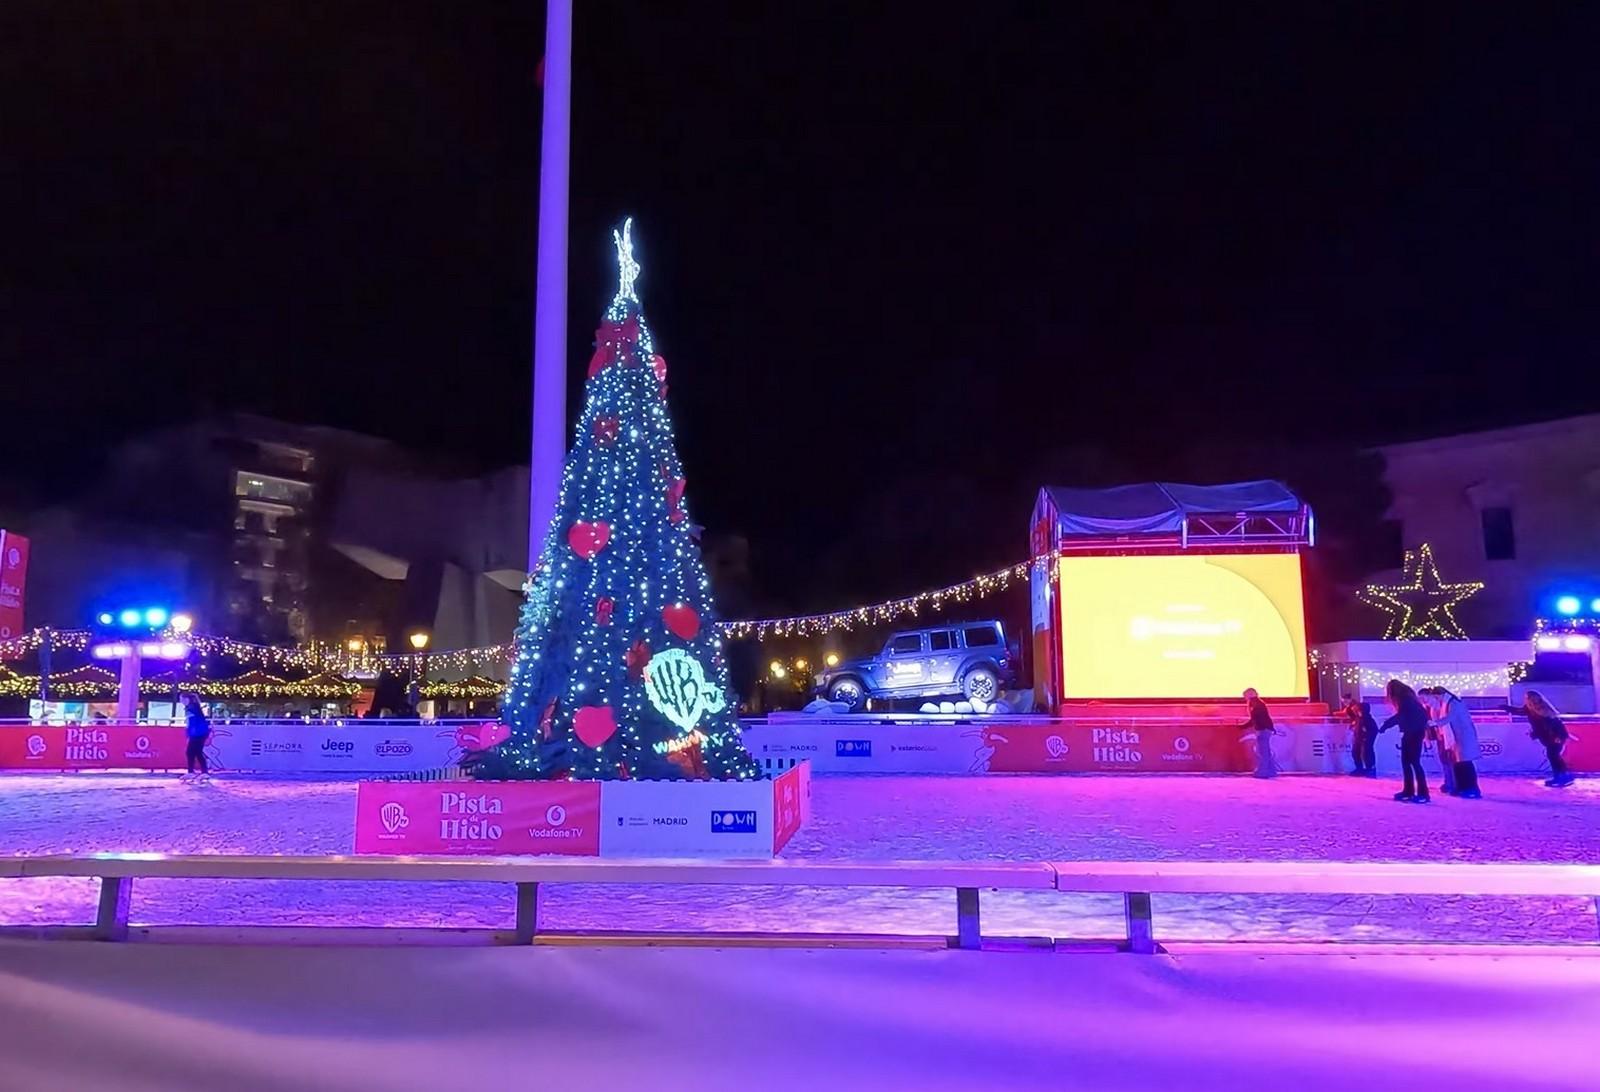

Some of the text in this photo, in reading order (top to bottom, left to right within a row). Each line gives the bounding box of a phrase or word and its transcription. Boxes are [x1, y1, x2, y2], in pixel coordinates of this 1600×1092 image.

[66, 728, 108, 743] Pista
[1093, 728, 1140, 744] Pista
[66, 746, 108, 760] Hielo
[321, 739, 354, 753] Jeep
[837, 742, 870, 752] DOWN
[1093, 746, 1142, 762] Hielo
[441, 792, 503, 814] Pista
[653, 817, 688, 826] MADRID
[713, 812, 755, 826] DOWN
[440, 818, 503, 840] Hielo
[529, 828, 583, 838] Vodafone TV
